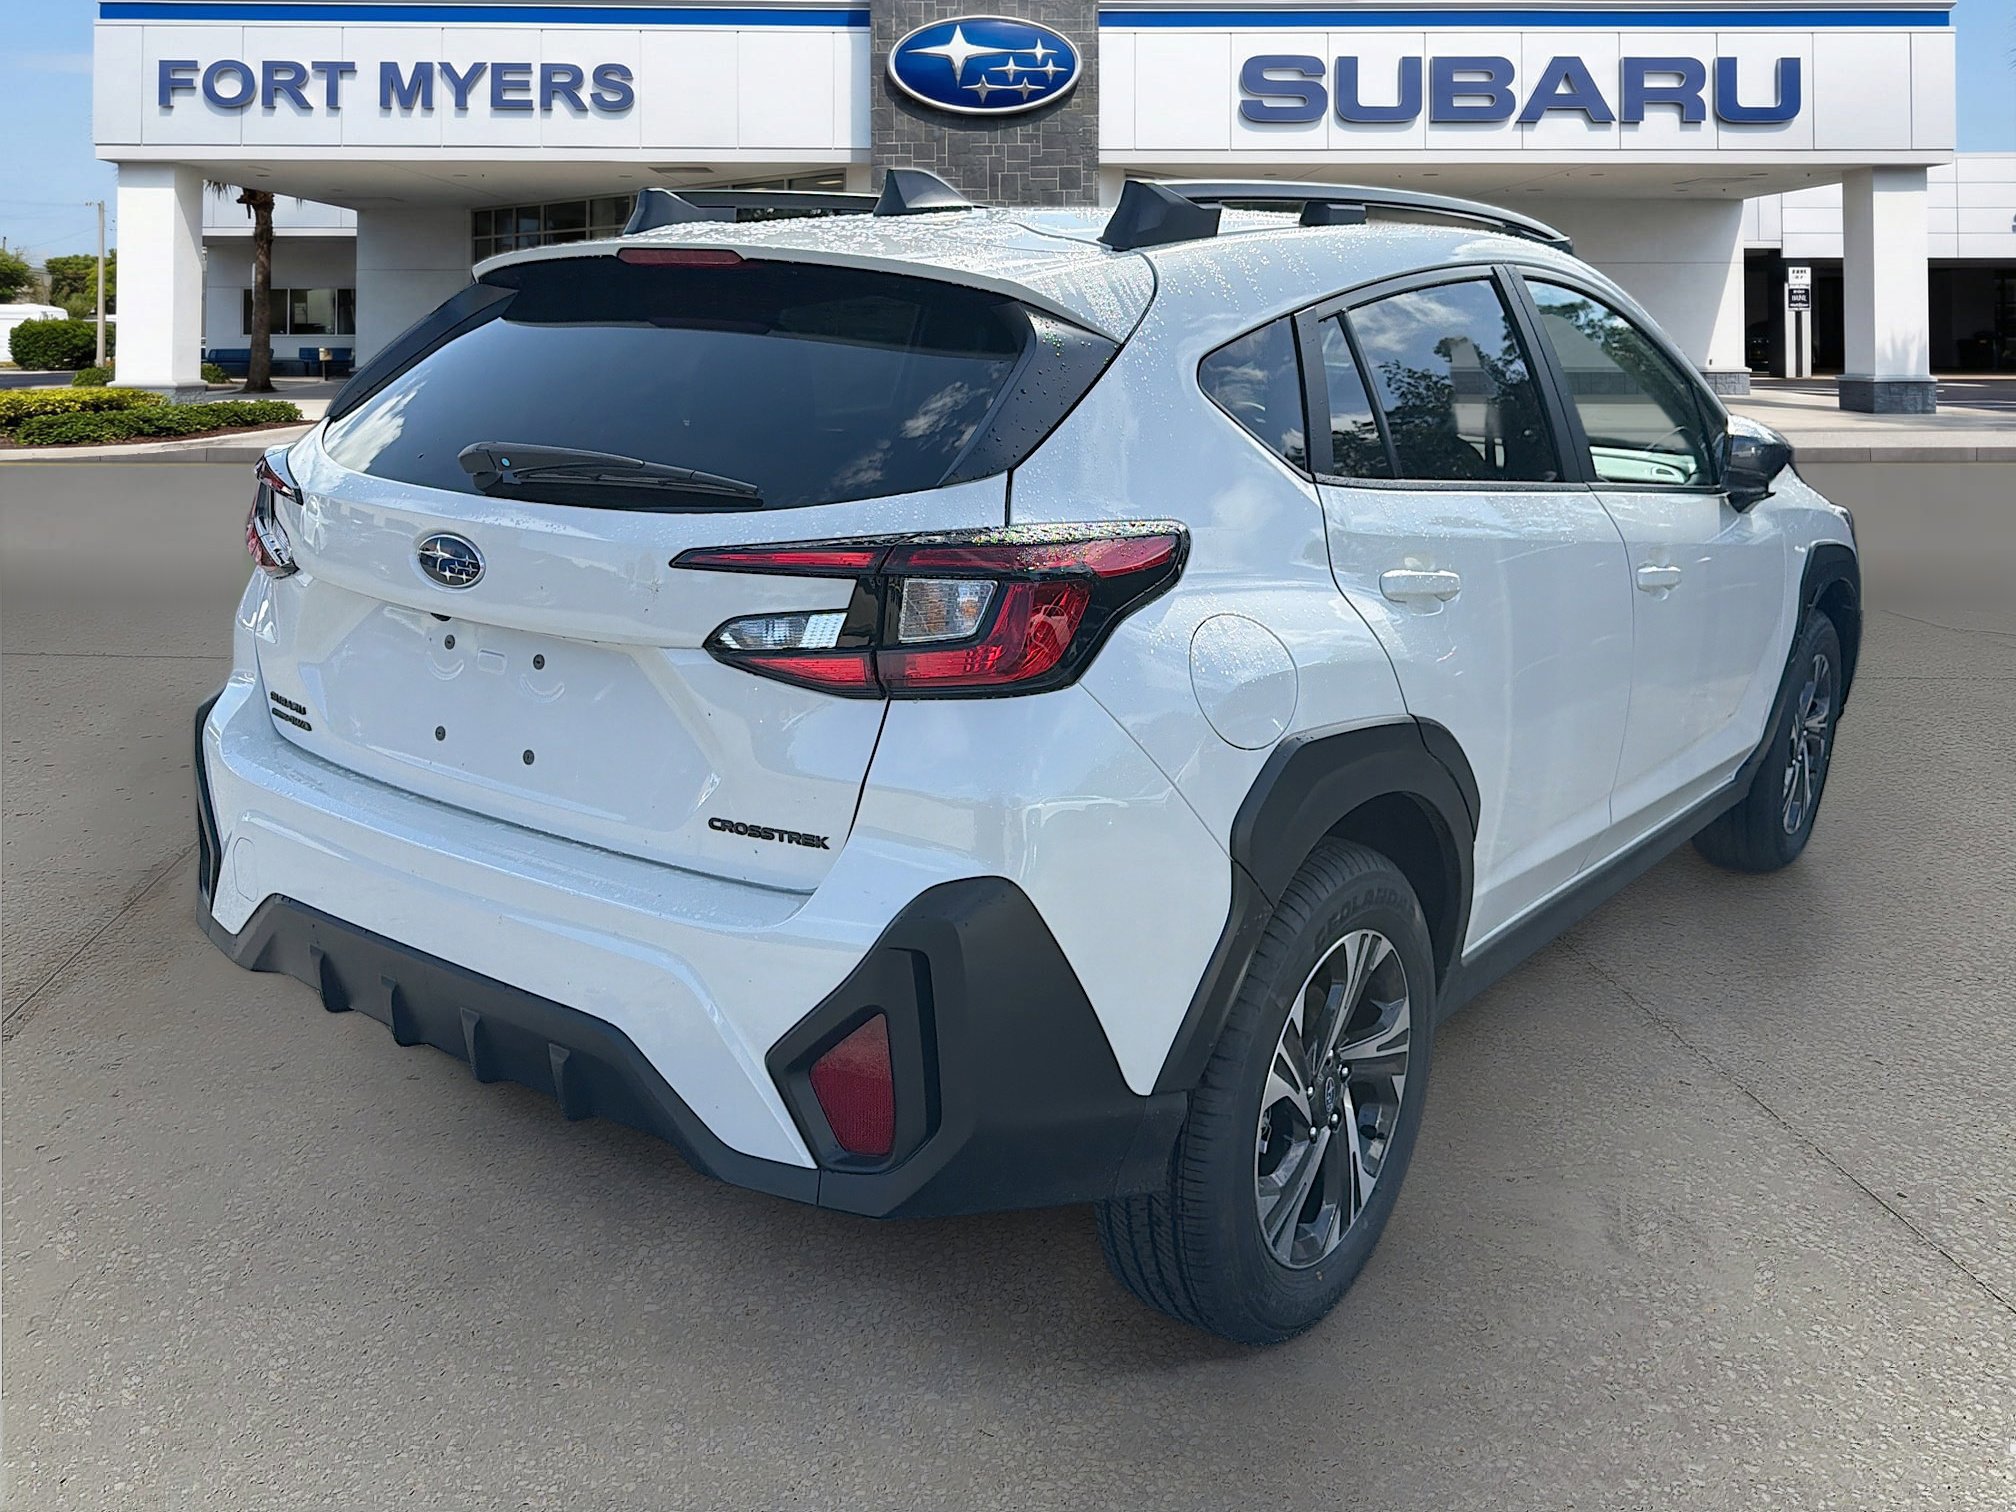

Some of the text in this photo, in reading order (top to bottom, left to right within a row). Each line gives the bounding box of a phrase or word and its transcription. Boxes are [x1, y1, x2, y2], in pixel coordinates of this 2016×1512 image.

[157, 58, 636, 112] FORT MYERS
[1239, 53, 1802, 125] SUBARU
[270, 690, 307, 715] SUBARU
[707, 816, 830, 850] CROSSTREK
